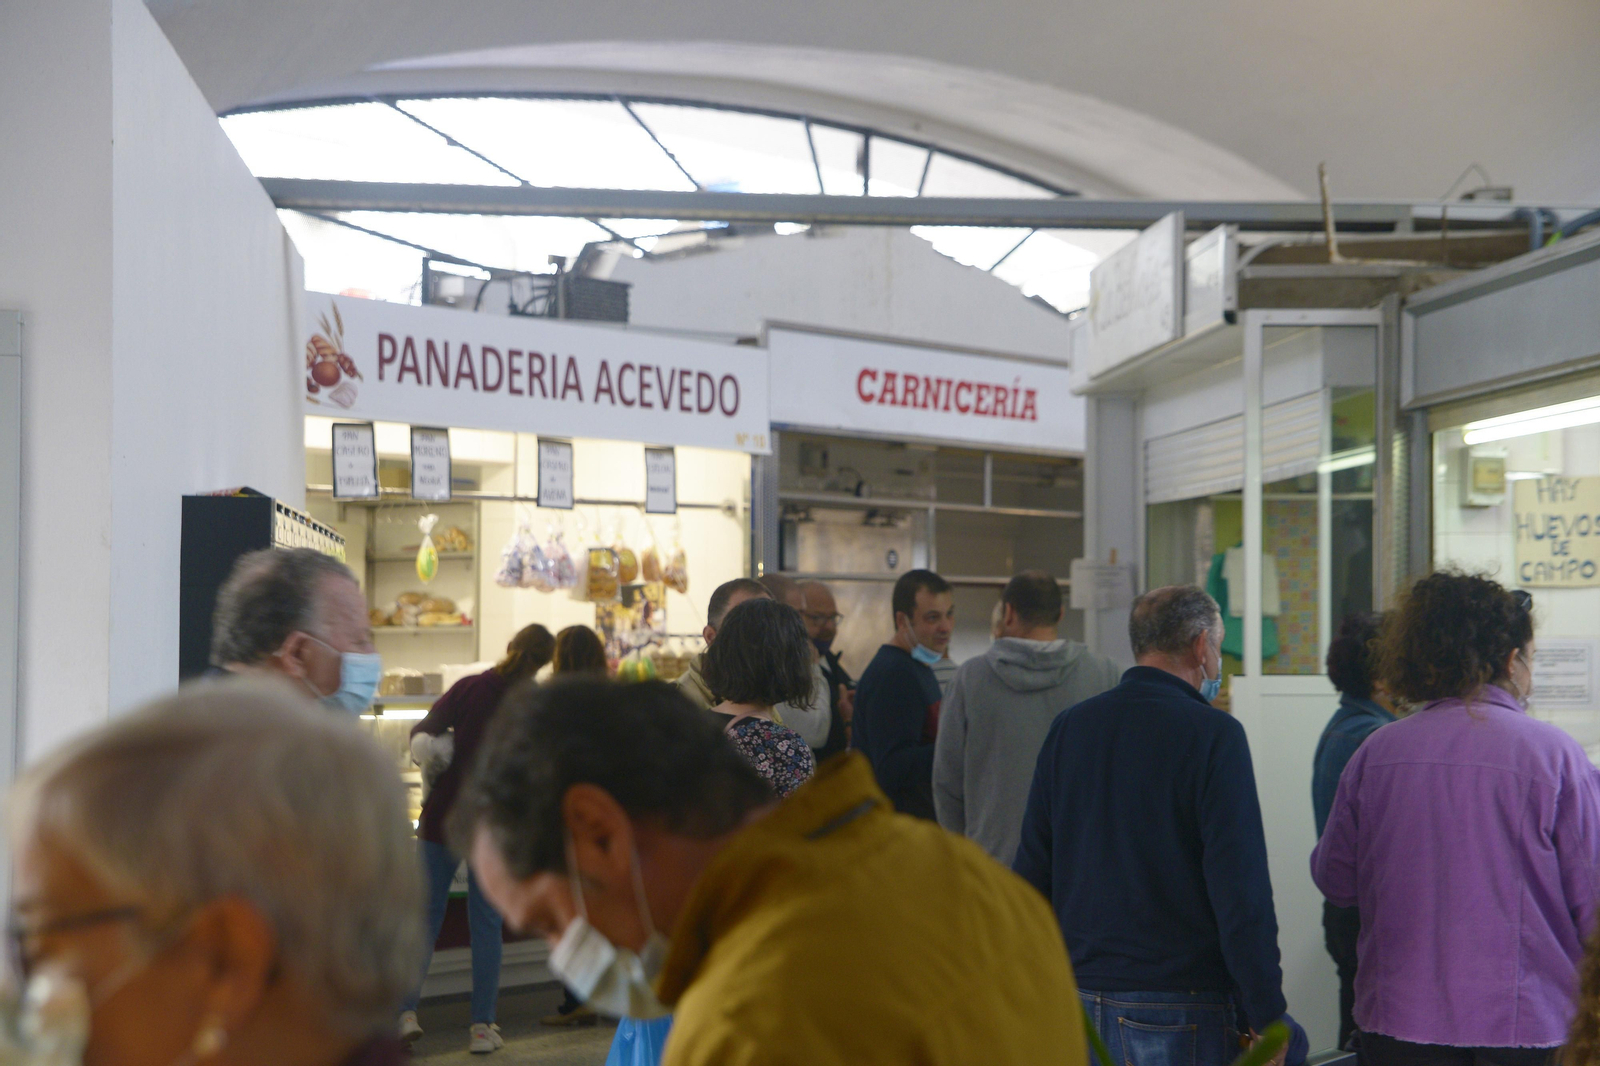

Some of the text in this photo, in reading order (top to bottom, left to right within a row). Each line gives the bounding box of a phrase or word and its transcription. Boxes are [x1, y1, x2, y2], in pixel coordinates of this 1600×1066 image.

[377, 332, 741, 418] PANADERIA ACEVEDO
[857, 367, 1038, 421] CARNICERÍA
[1536, 475, 1581, 502] HAY
[1551, 540, 1570, 557] DE
[1520, 560, 1596, 581] CAMPO
